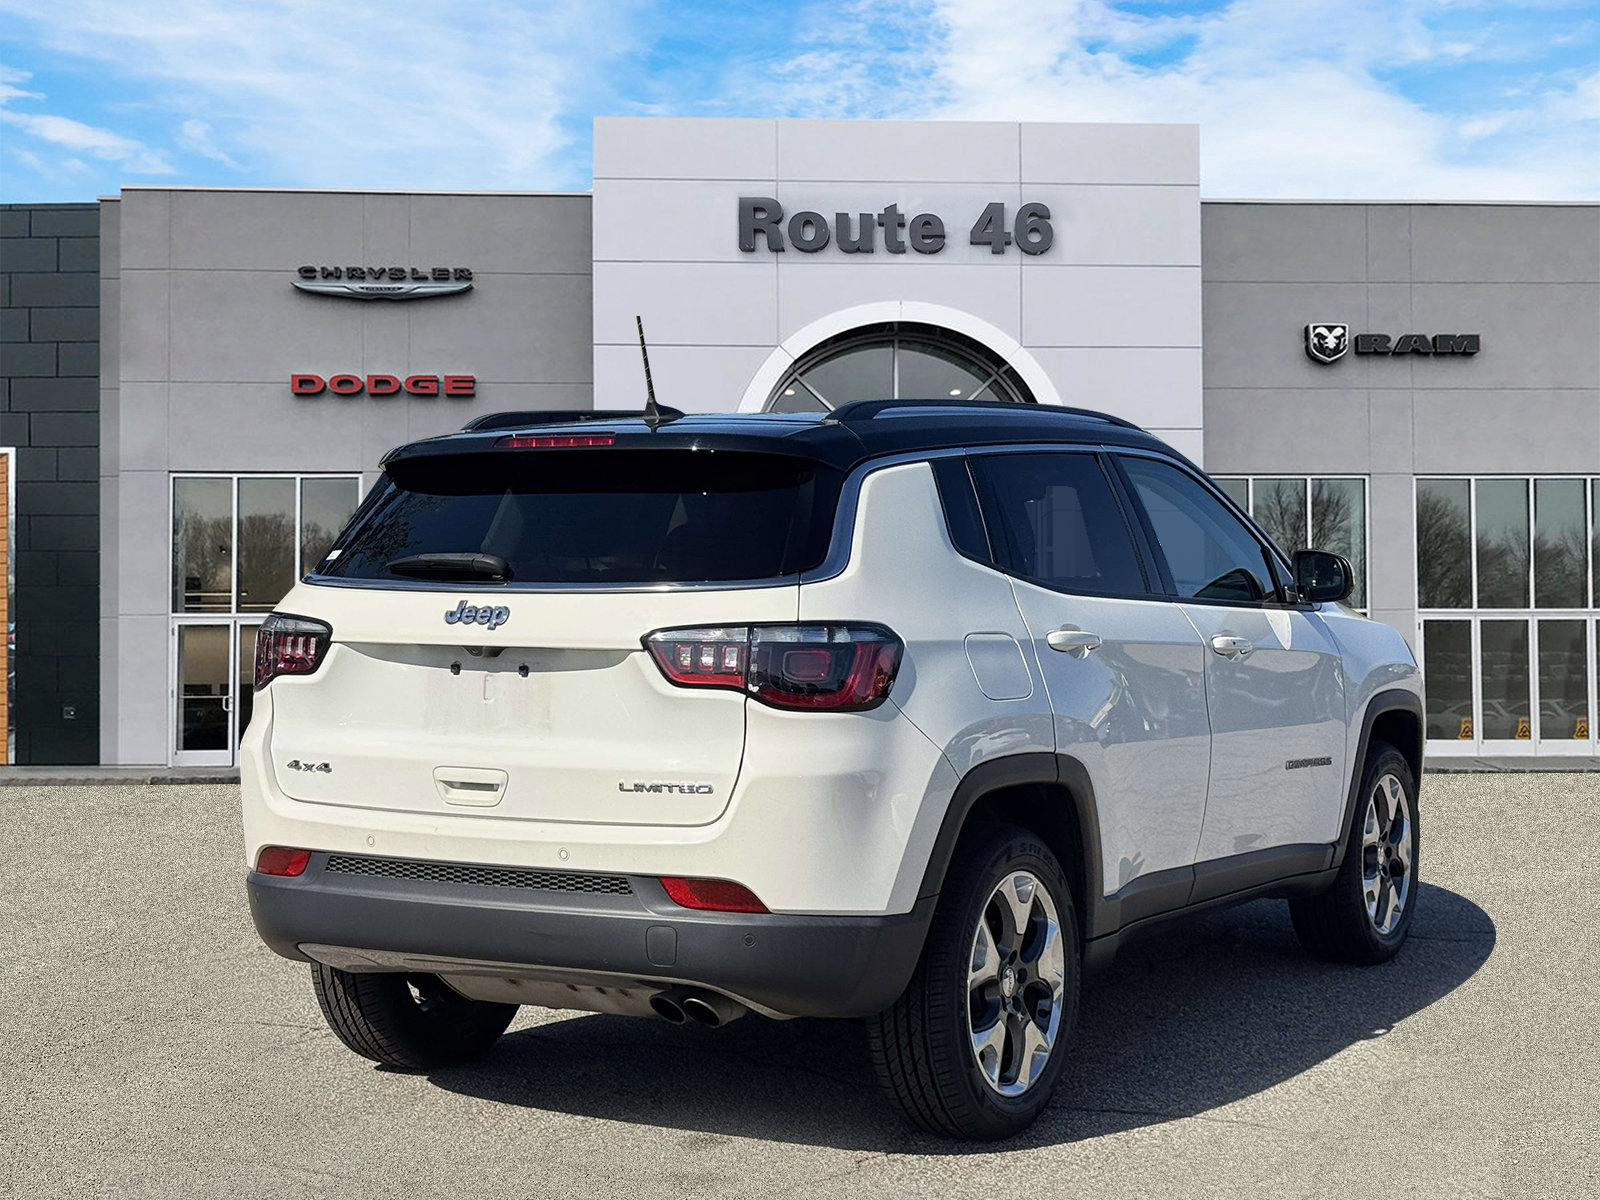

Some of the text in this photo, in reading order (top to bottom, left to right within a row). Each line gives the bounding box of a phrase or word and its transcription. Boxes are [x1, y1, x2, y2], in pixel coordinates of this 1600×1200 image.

[738, 197, 1054, 256] Route 46
[298, 266, 473, 280] CHRYSLER
[1355, 333, 1481, 357] RAM
[291, 374, 476, 397] DODGE
[445, 600, 510, 630] Jeep
[286, 759, 332, 774] 4x4
[618, 781, 714, 795] LIMITED
